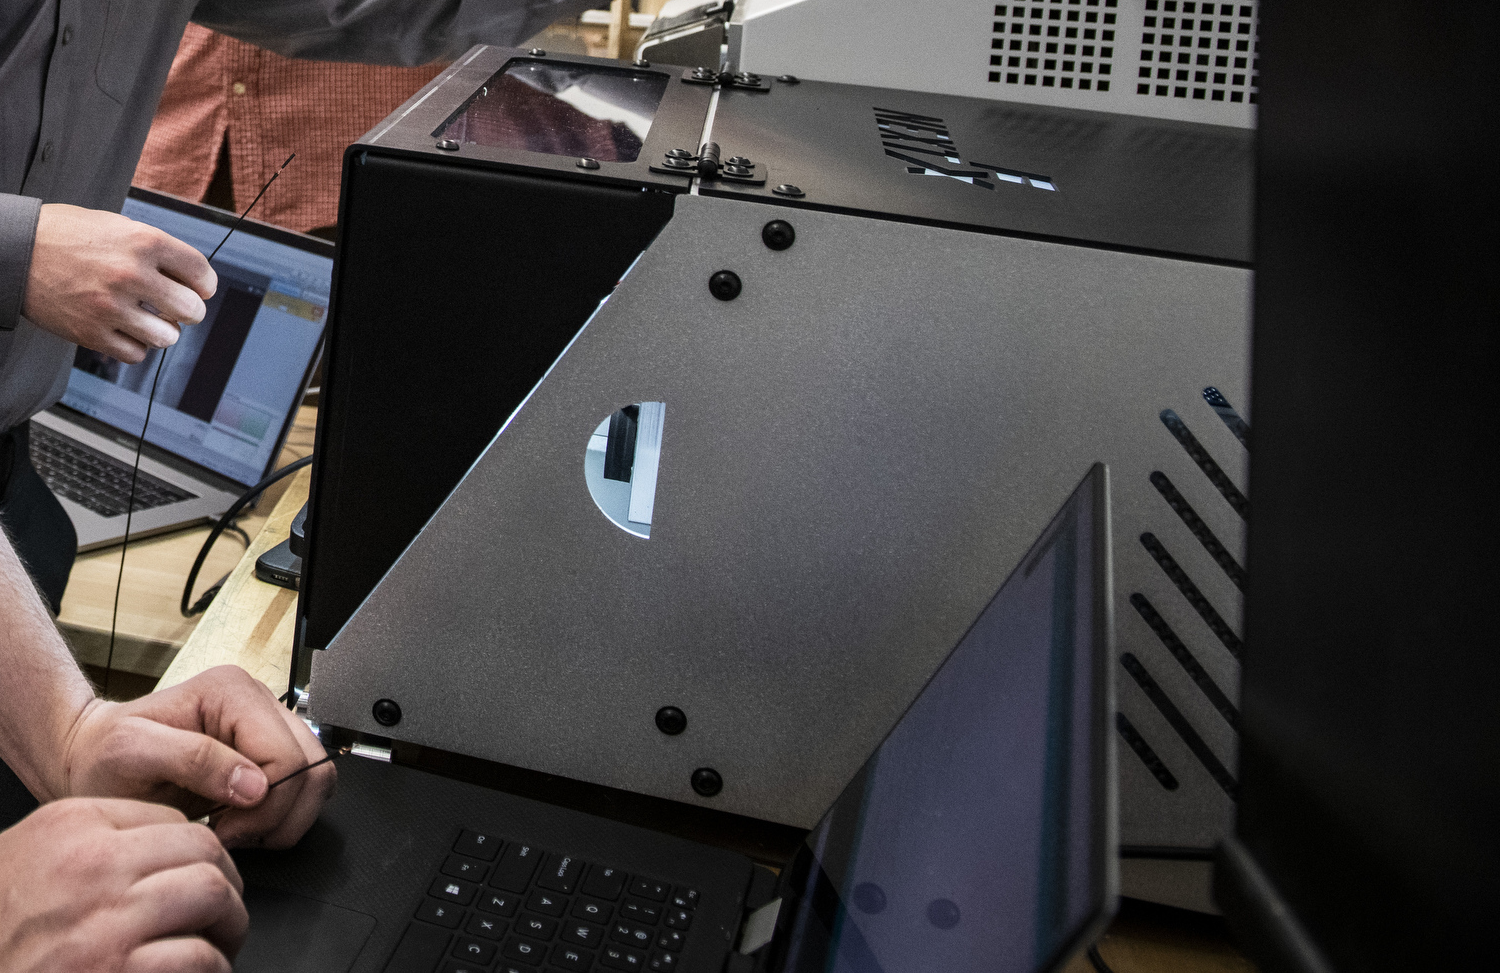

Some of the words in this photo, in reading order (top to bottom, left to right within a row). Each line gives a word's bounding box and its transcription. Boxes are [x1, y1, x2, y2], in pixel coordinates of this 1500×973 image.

[492, 897, 505, 907] Z
[541, 897, 552, 906] A
[585, 904, 599, 914] Q
[481, 920, 494, 930] X
[530, 920, 542, 930] S
[576, 927, 590, 939] W
[617, 926, 629, 935] 2
[633, 929, 647, 940] @
[468, 943, 481, 954] C
[518, 943, 532, 954] D
[565, 951, 579, 962] E
[608, 950, 620, 959] 3
